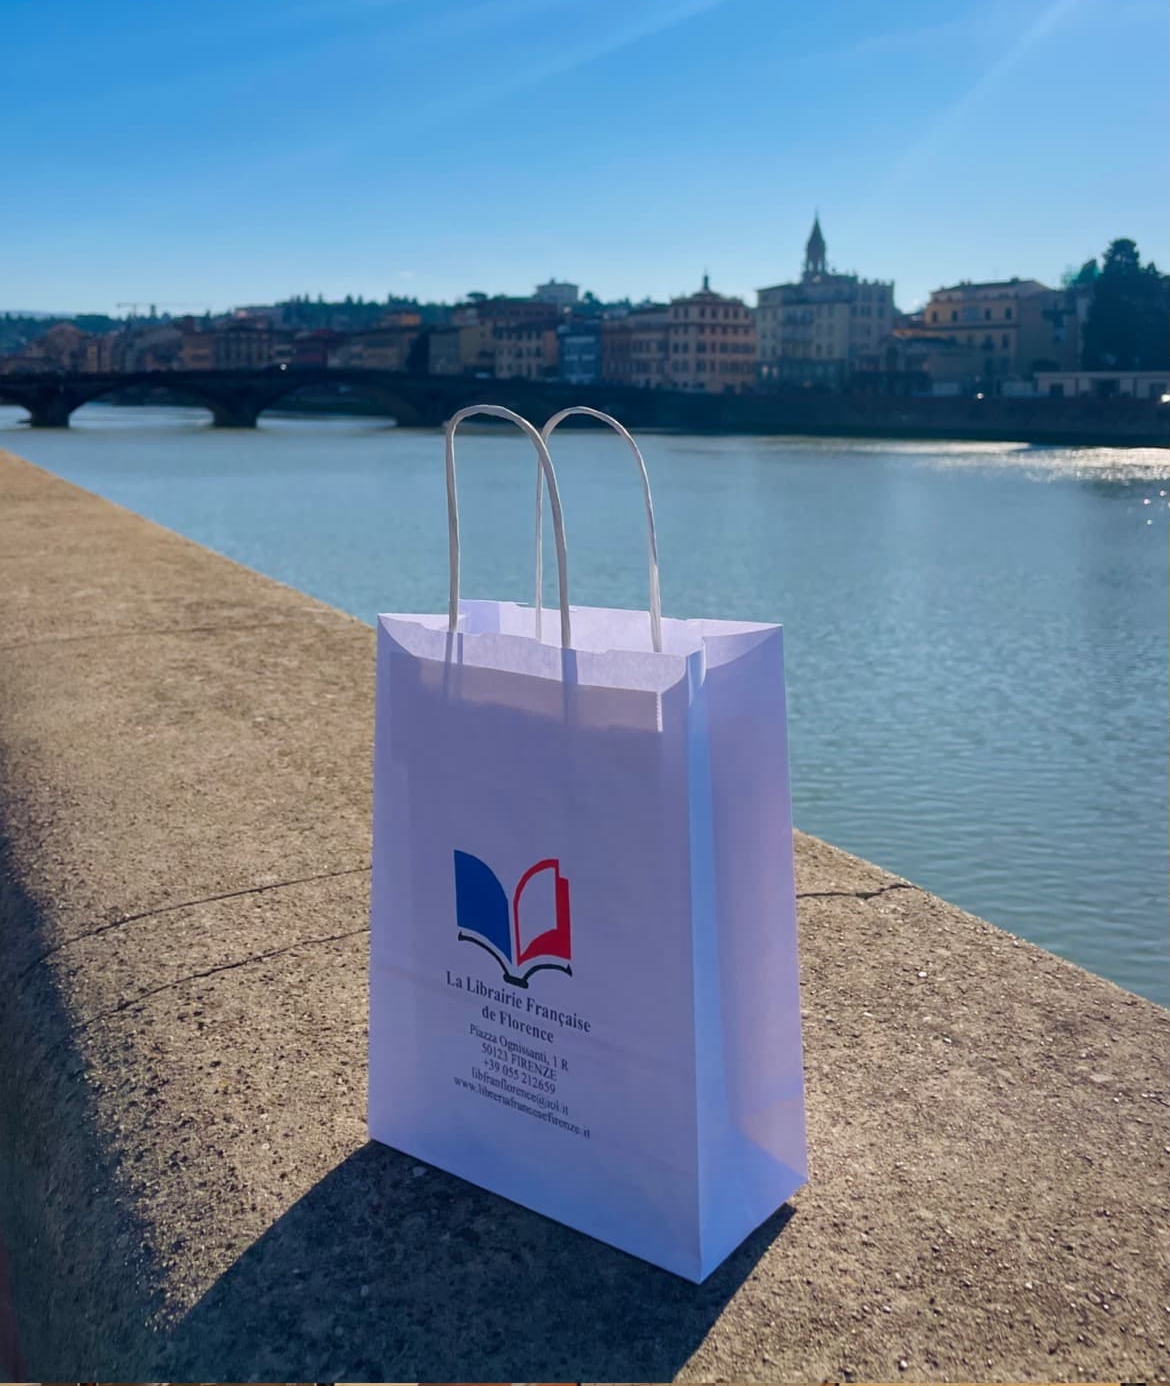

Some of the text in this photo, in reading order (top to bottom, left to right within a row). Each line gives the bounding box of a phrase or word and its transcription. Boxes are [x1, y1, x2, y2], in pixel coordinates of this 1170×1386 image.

[446, 971, 591, 1033] La Librairie Française
[481, 1005, 554, 1043] de Florence
[469, 1023, 497, 1043] Piazza
[561, 1058, 569, 1072] R
[481, 1043, 557, 1081] 50123 FIRENZE
[484, 1058, 556, 1094] +39 055 212659
